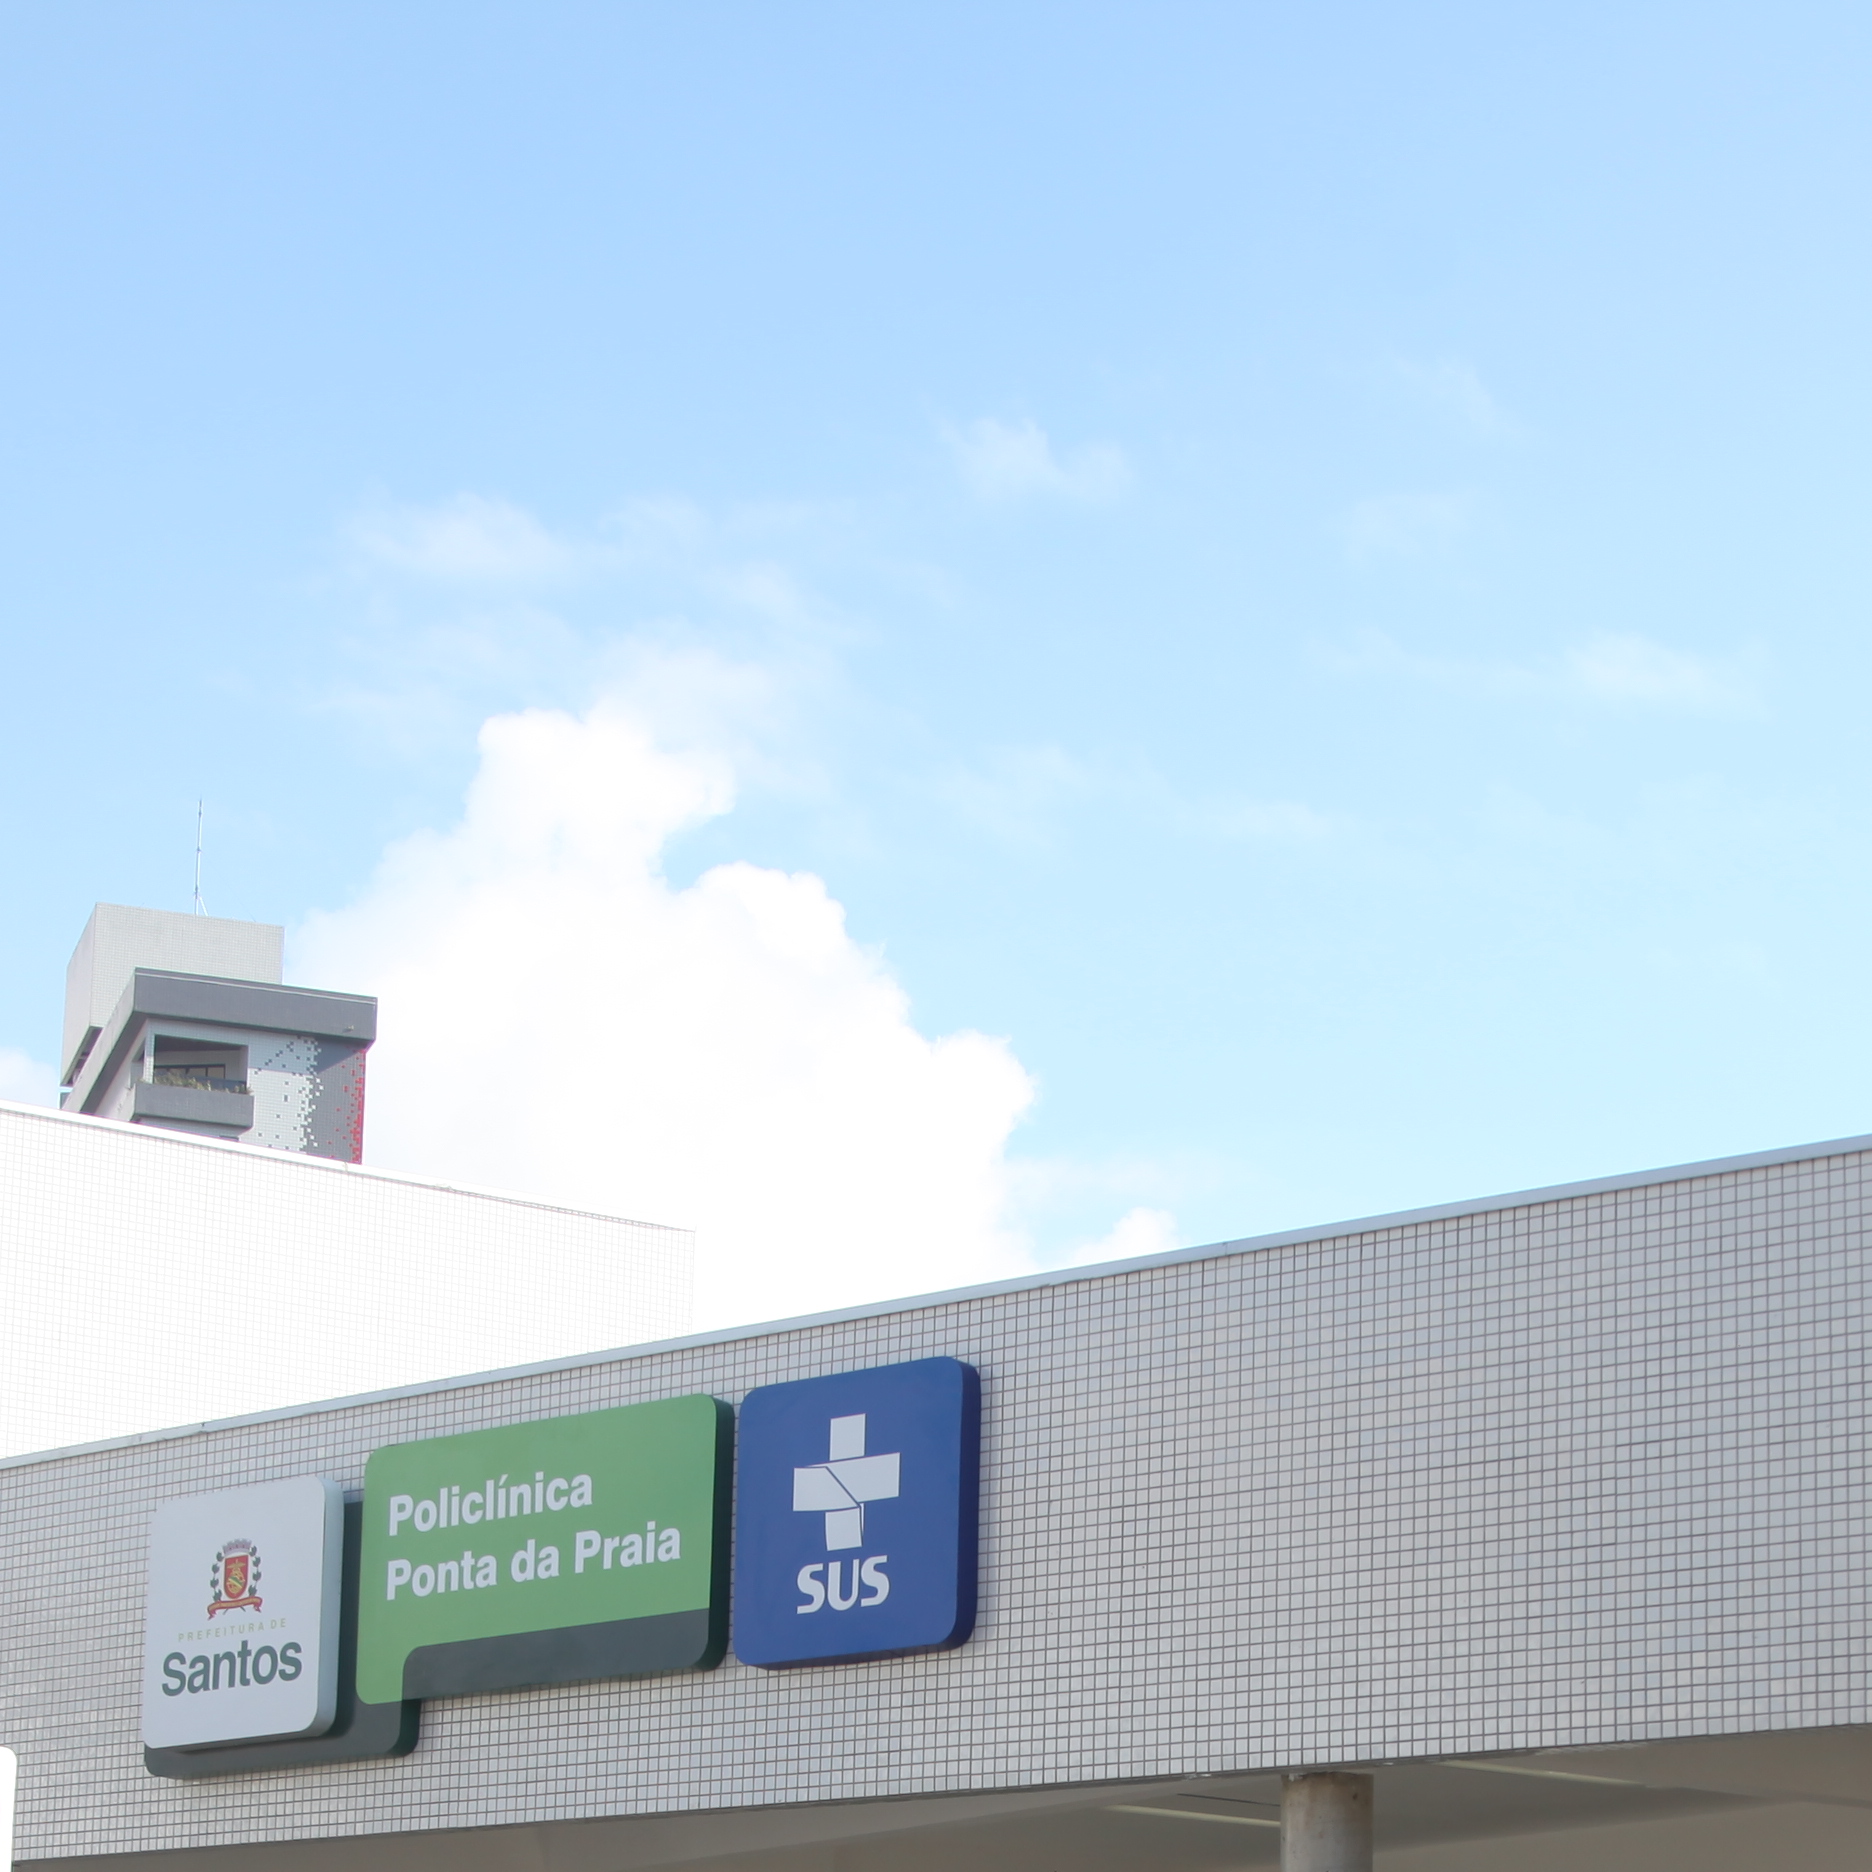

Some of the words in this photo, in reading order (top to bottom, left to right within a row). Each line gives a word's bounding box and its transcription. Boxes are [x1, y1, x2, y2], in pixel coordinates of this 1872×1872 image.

[388, 1471, 593, 1536] Policlínica
[386, 1550, 498, 1601] Ponta
[510, 1538, 560, 1583] da
[574, 1520, 681, 1574] Praia
[796, 1554, 890, 1615] SUS
[178, 1622, 265, 1643] PREFEITURA
[271, 1618, 287, 1630] DE
[161, 1640, 303, 1697] Santos
